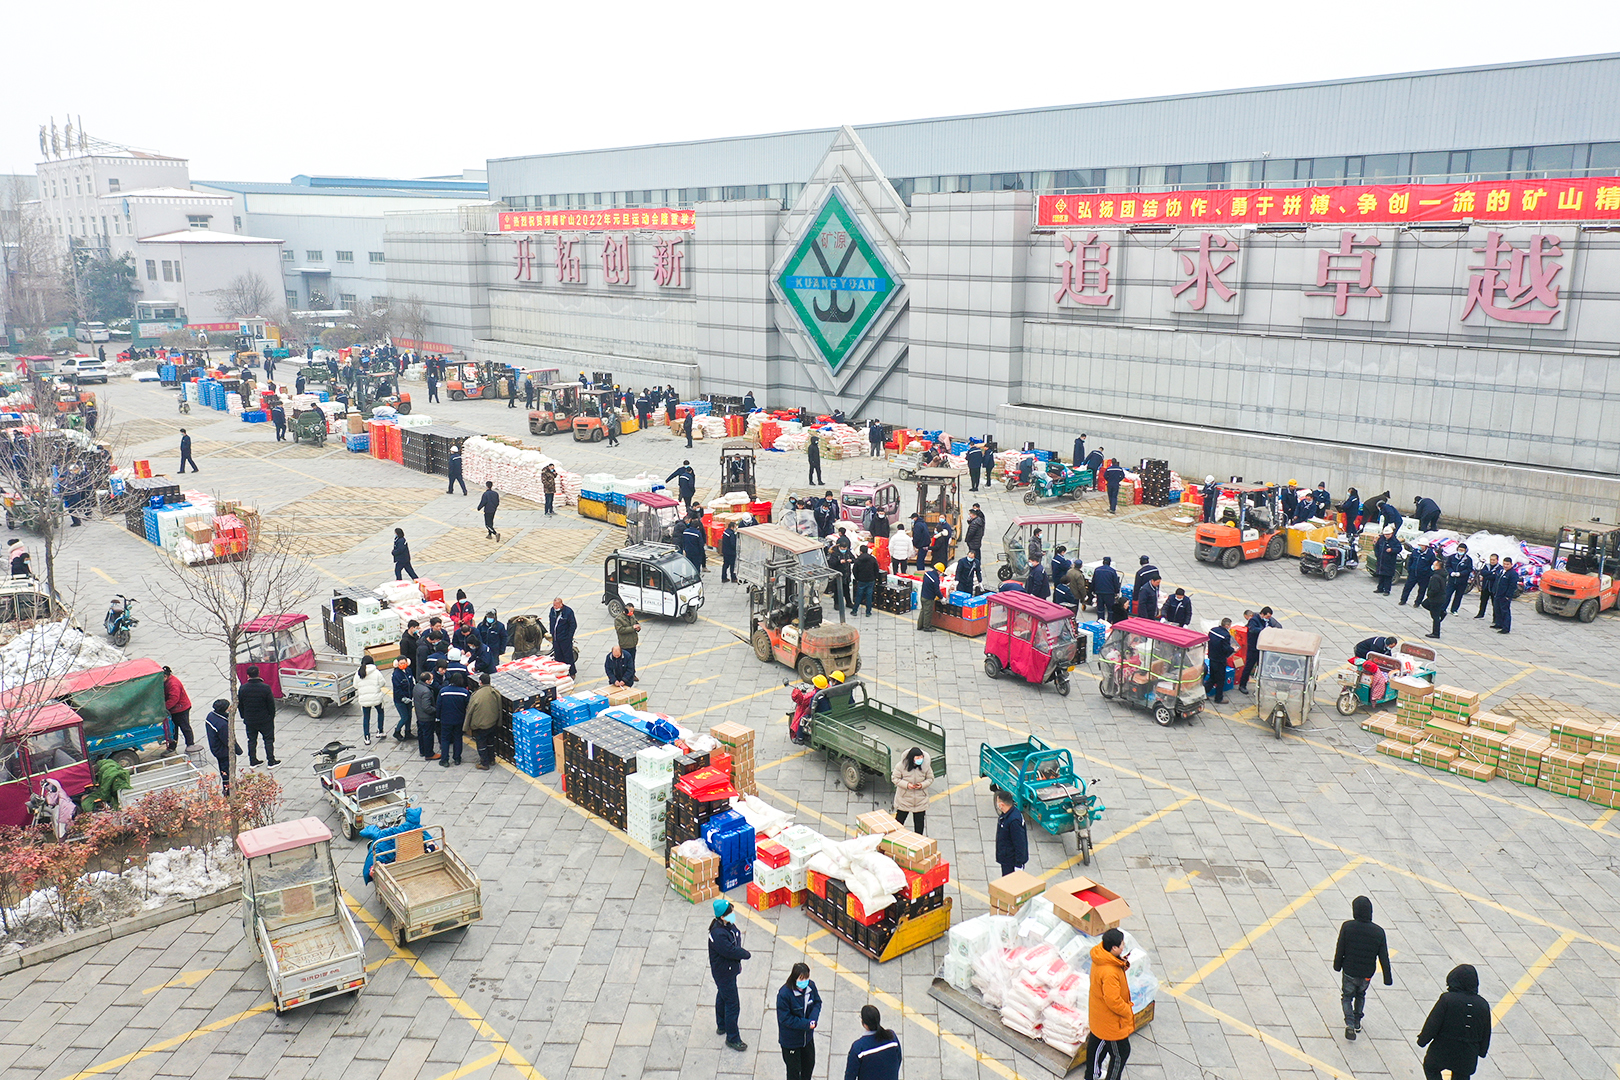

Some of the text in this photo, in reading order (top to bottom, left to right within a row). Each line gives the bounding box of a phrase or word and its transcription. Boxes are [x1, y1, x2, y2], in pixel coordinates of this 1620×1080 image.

[512, 235, 684, 287] 开拓创新
[820, 231, 847, 249] 矿源
[1053, 231, 1564, 325] 追求卓越
